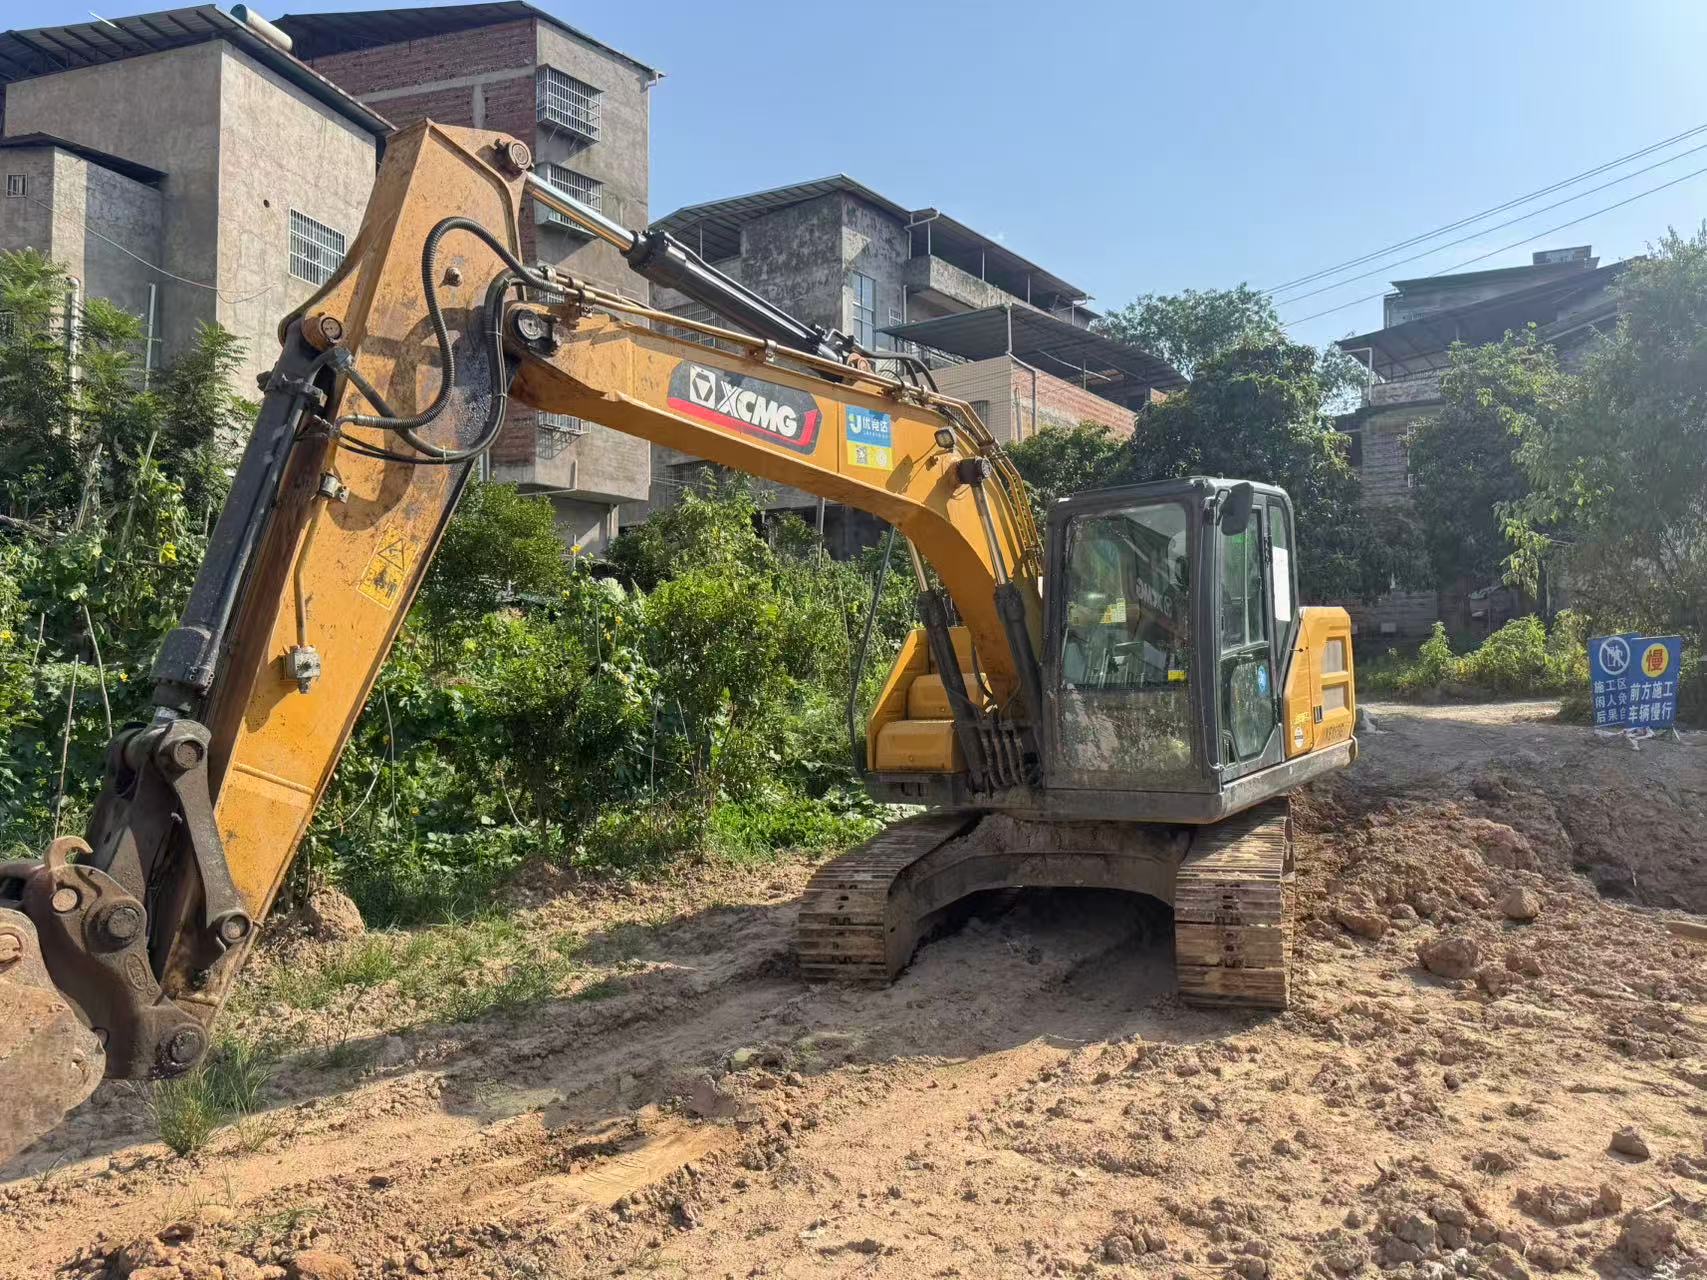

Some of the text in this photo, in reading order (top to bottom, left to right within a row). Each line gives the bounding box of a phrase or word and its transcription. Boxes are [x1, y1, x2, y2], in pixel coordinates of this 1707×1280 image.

[715, 380, 797, 437] XCMG
[1646, 649, 1663, 671] 慢
[1594, 677, 1627, 693] 施工区
[1630, 681, 1673, 701] 前方施工
[1628, 702, 1672, 722] 车辆慢行
